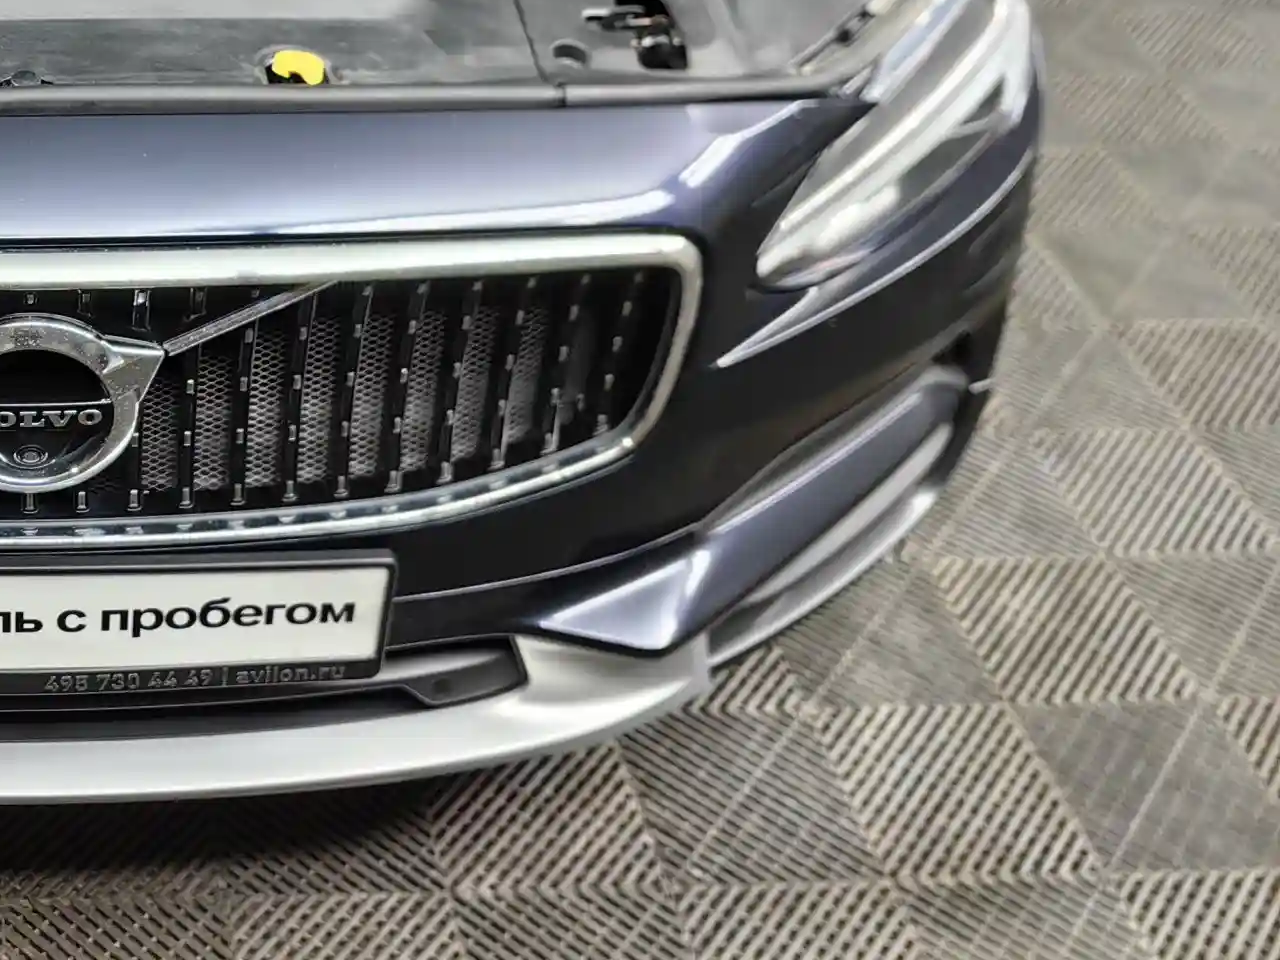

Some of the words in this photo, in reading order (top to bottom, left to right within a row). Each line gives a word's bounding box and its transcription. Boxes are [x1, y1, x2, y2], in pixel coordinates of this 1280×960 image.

[56, 609, 87, 633] с
[100, 597, 356, 638] пробегом
[44, 674, 89, 691] 495
[96, 672, 140, 690] 730
[235, 664, 346, 685] avilon.ru
